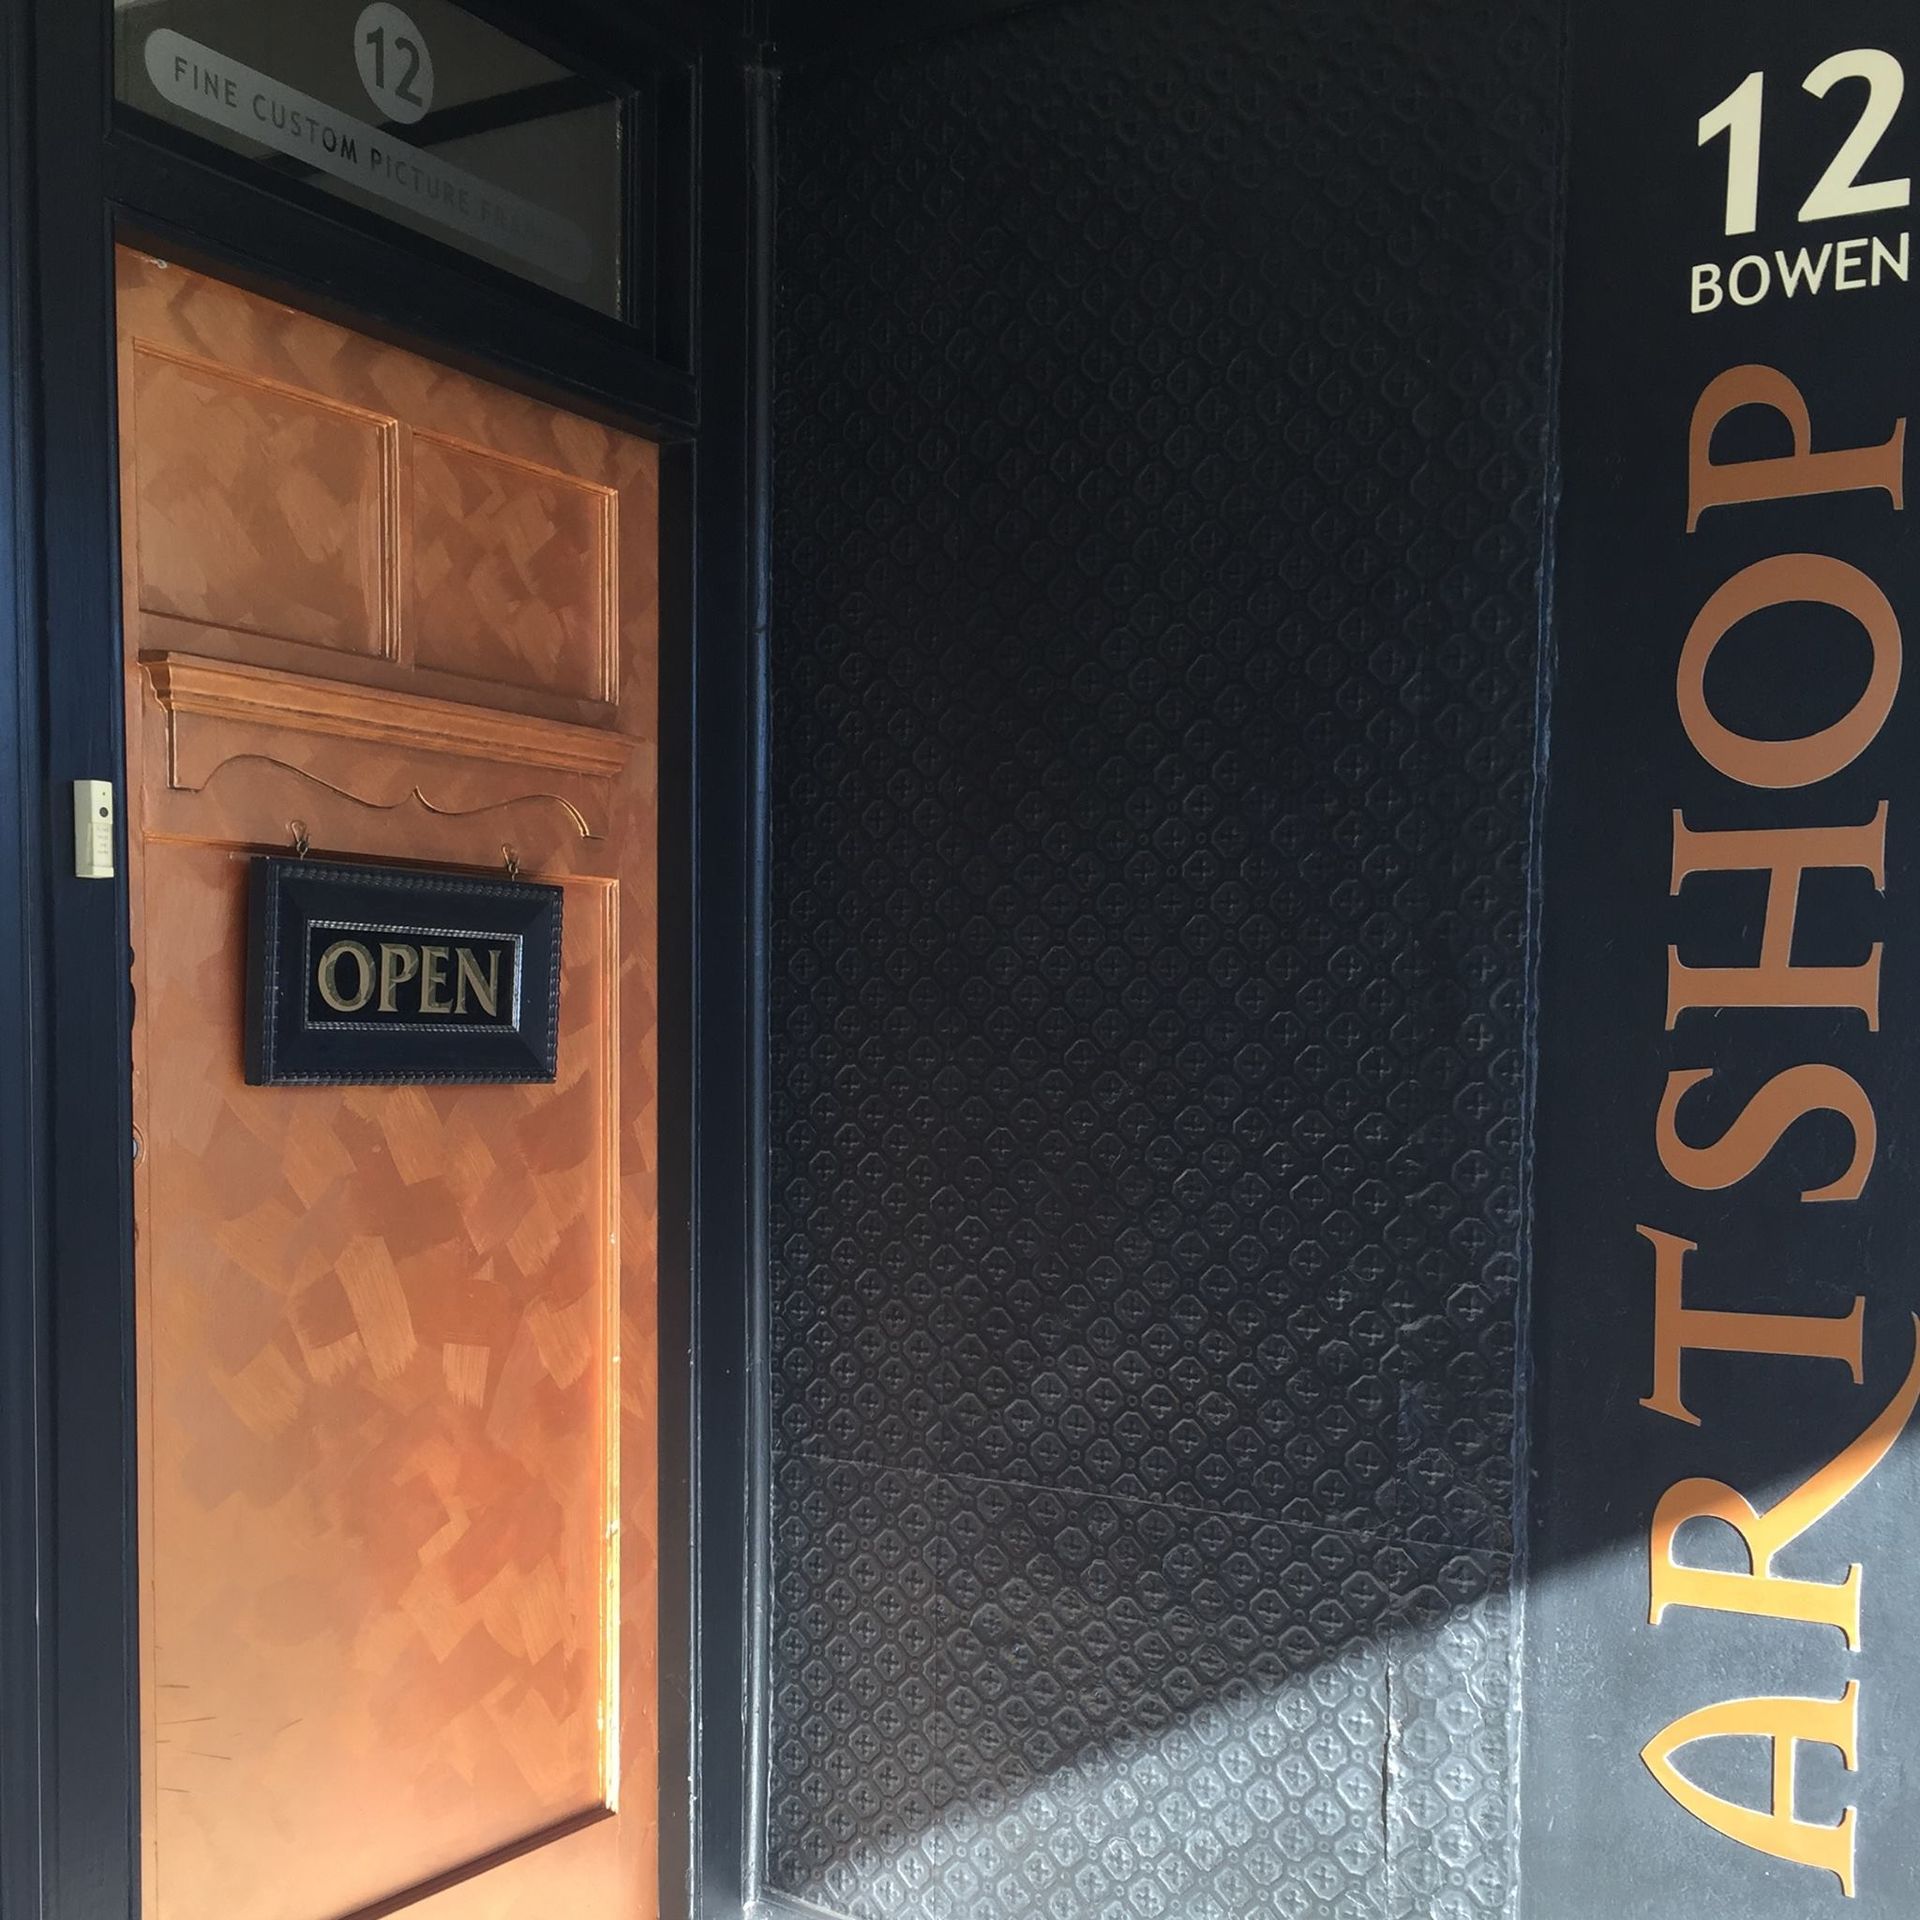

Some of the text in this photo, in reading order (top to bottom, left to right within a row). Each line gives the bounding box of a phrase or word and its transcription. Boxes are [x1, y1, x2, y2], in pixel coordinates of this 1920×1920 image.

[365, 26, 423, 107] 12
[174, 56, 470, 214] FINE CUSTOM PICTURE
[1697, 48, 1911, 236] 12
[1690, 232, 1910, 314] BOWEN
[317, 939, 502, 1018] OPEN
